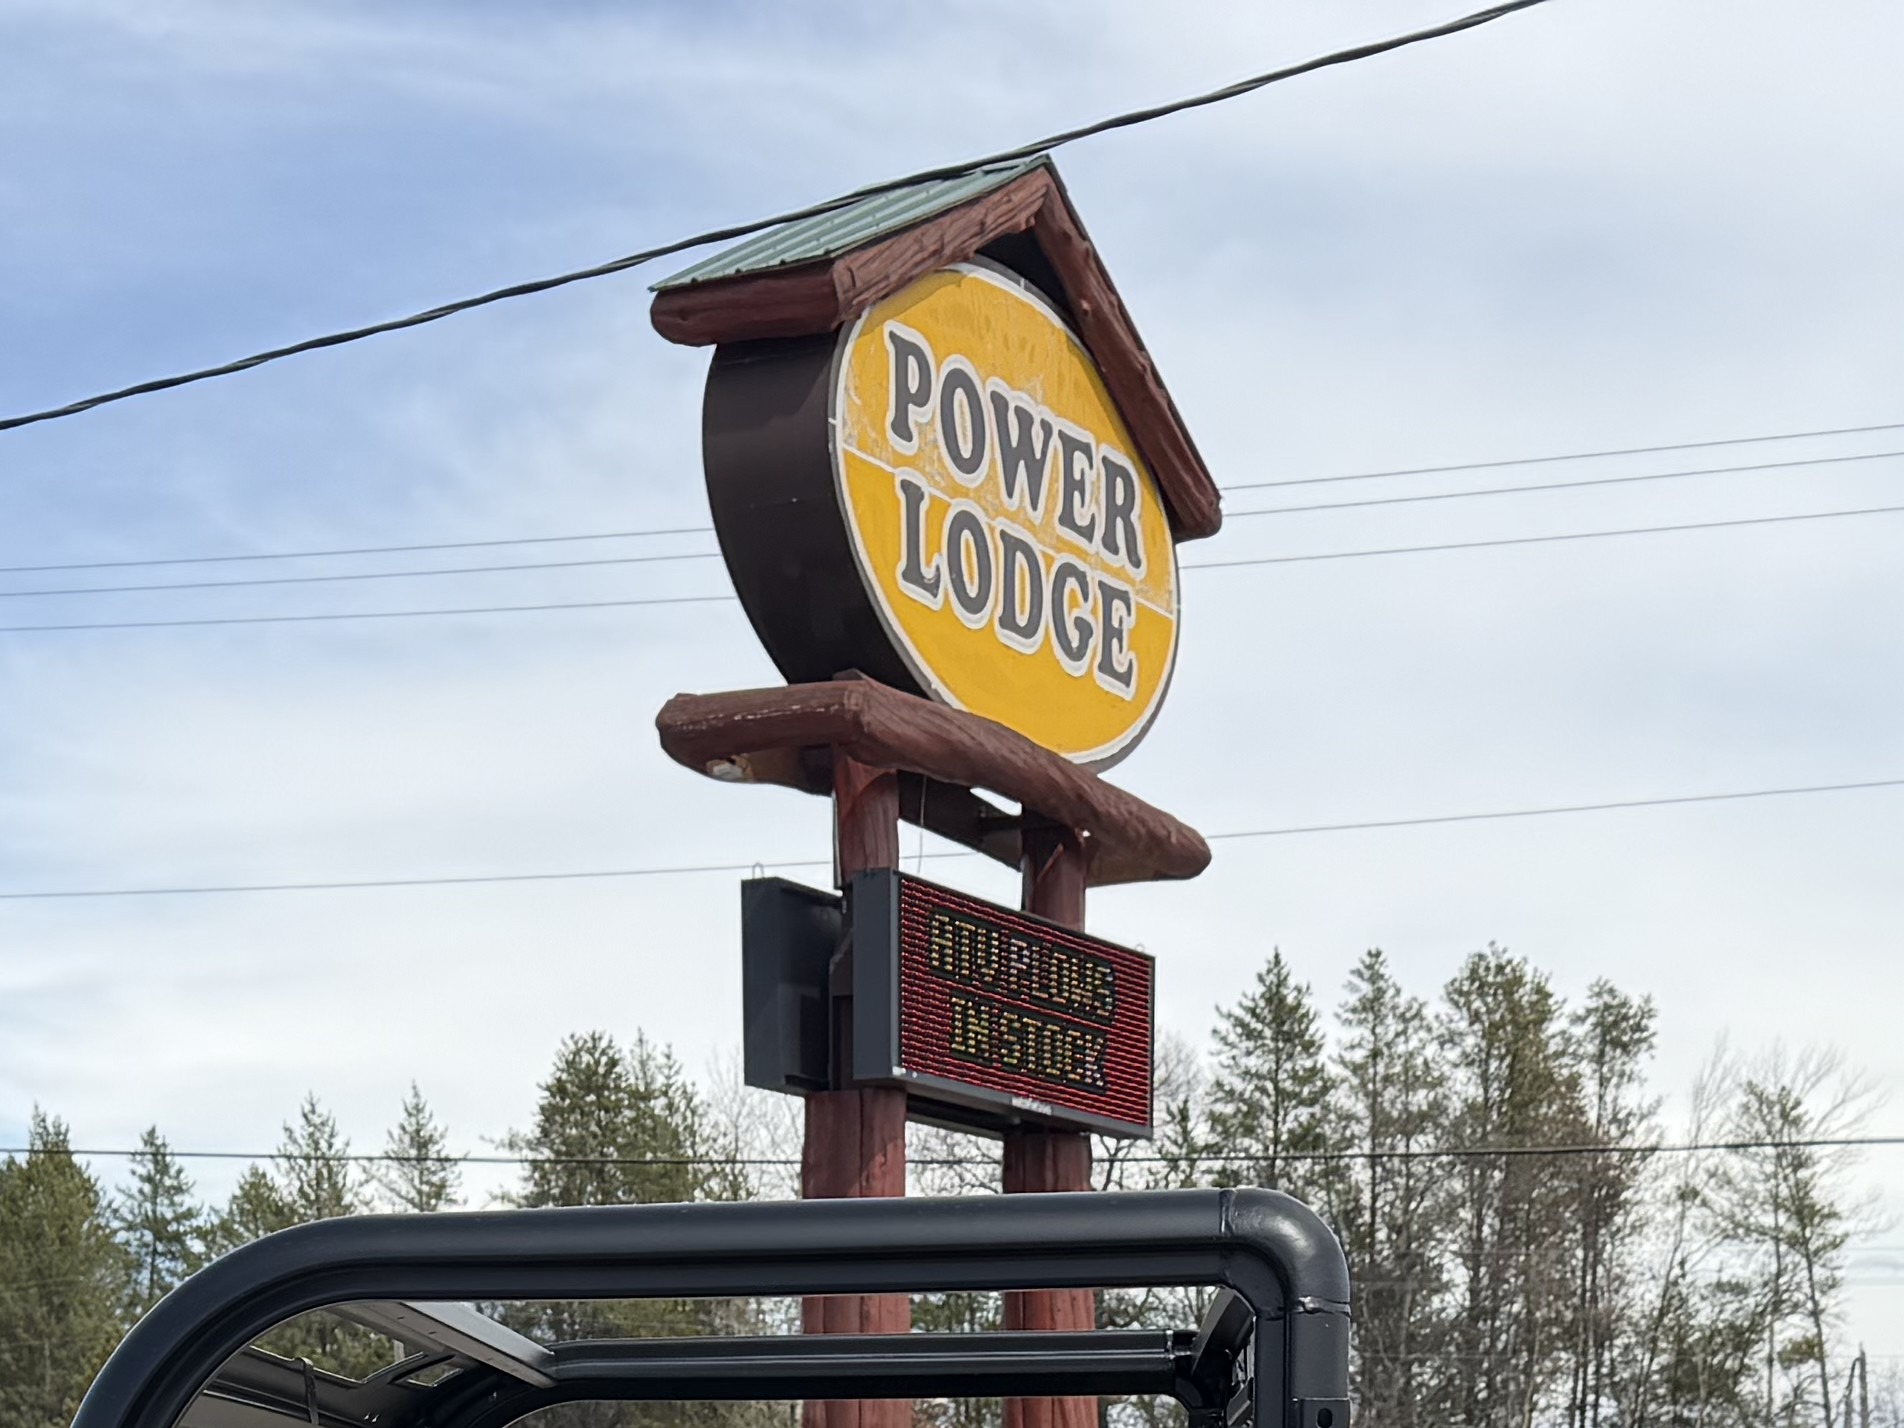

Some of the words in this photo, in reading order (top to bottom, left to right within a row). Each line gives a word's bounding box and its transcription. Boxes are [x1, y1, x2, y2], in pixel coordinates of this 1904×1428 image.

[888, 329, 1142, 570] POWER
[900, 478, 1134, 689] LODGE
[950, 996, 990, 1059] IN
[999, 1010, 1105, 1088] STOCK
[1010, 938, 1114, 1018] PLOWS
